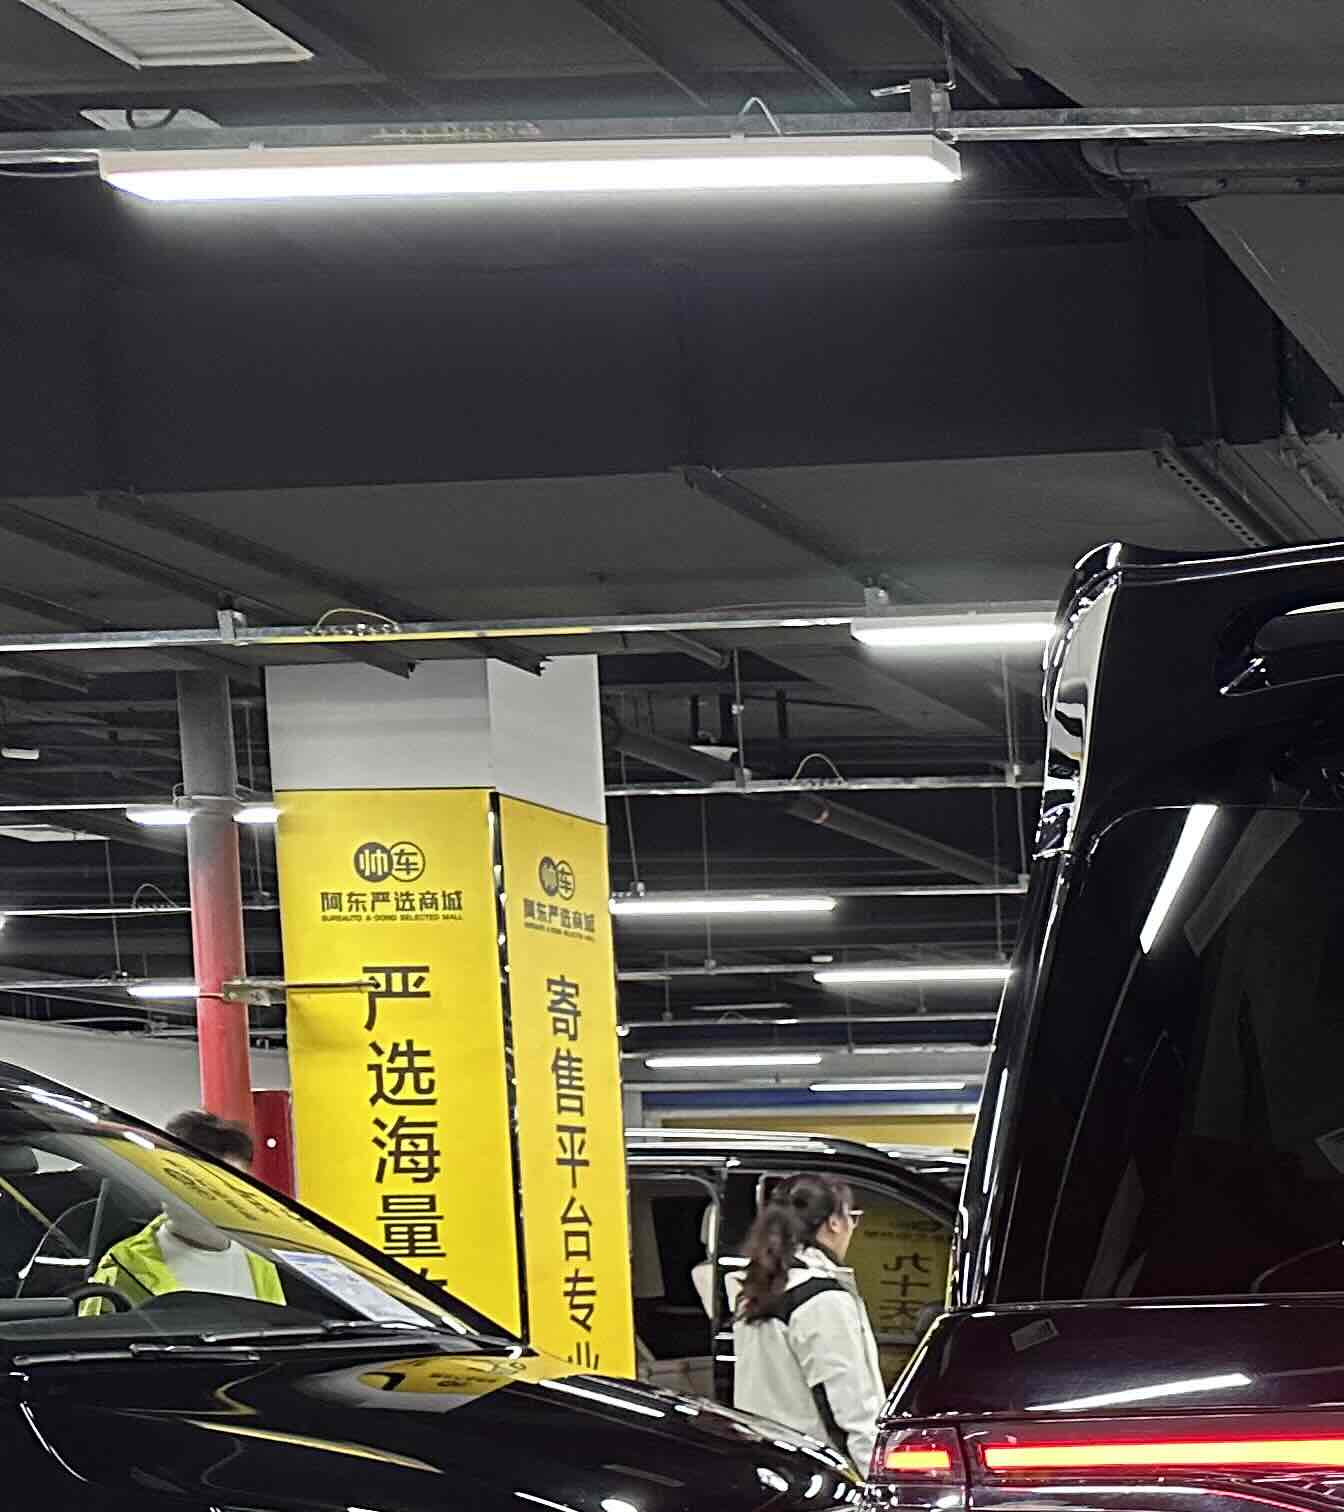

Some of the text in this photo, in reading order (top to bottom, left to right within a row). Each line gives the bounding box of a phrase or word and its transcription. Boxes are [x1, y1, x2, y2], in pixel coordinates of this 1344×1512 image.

[320, 890, 463, 912] 阿东严选商城
[361, 965, 448, 1286] 严选海量
